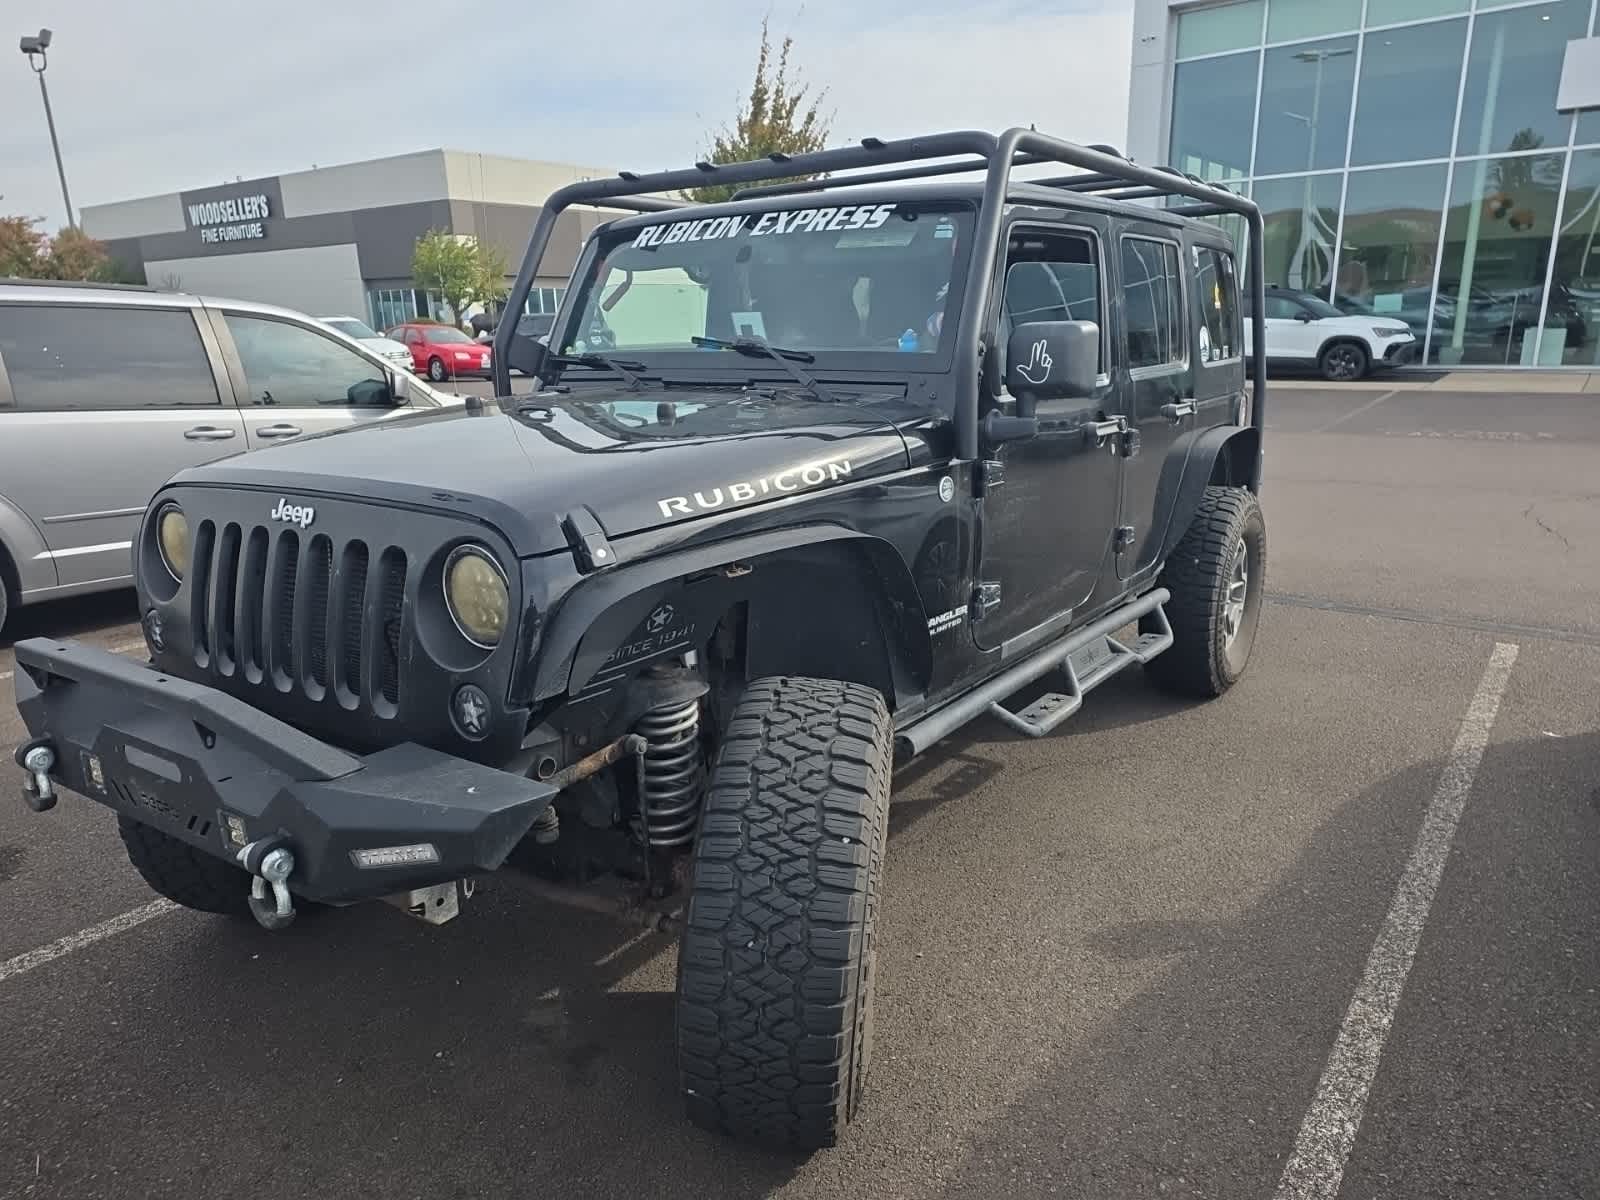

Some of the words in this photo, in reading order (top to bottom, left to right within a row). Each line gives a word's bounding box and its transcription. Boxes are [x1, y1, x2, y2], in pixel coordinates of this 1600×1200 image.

[188, 195, 269, 226] WOODSELLER'S
[631, 215, 751, 249] RUBICON
[749, 203, 897, 237] EXPRESS
[201, 228, 219, 244] FINE
[219, 223, 263, 241] FURNITURE
[657, 460, 851, 518] RUBICON
[271, 498, 314, 529] Jeep
[928, 605, 968, 627] ANGLER
